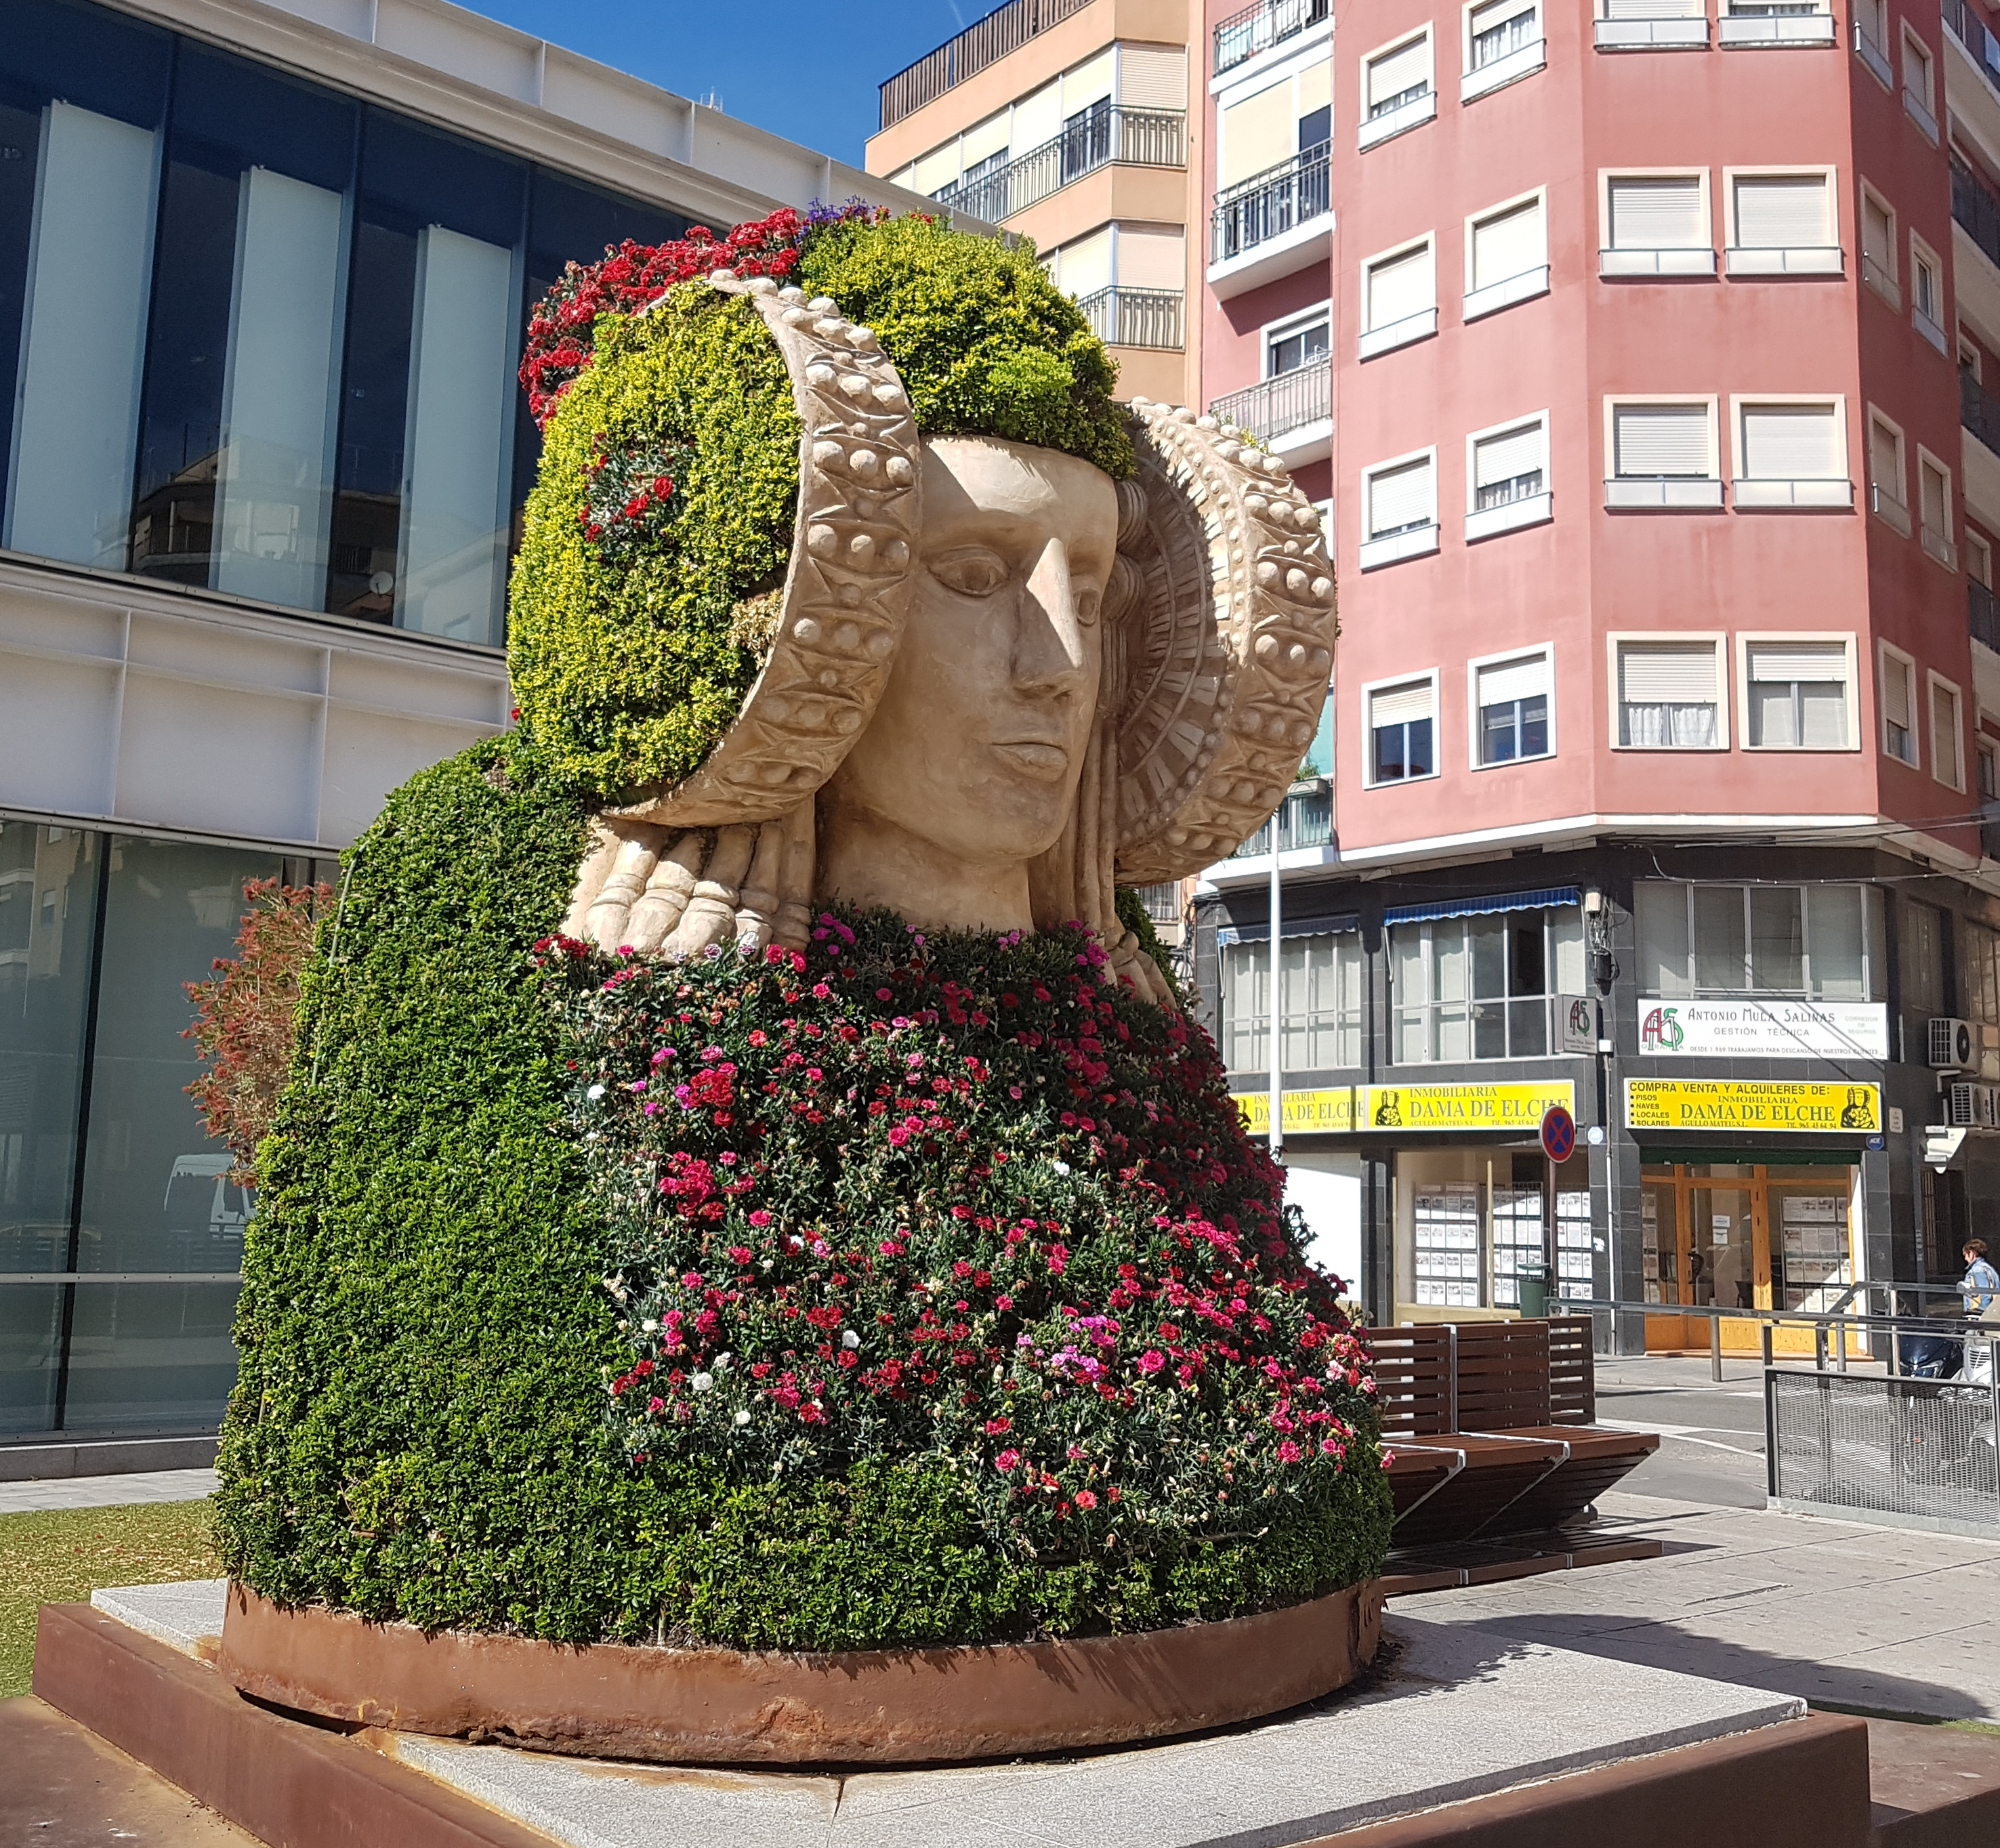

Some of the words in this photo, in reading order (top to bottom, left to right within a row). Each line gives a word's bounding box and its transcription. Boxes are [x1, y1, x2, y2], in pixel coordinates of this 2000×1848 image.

[1688, 1008, 1736, 1021] ANTONIO
[1743, 1008, 1774, 1022] MULA
[1784, 1009, 1835, 1022] SALINAS
[1714, 1026, 1757, 1035] GESTIÓN
[1767, 1028, 1810, 1036] TÉCNICA
[1410, 1086, 1497, 1097] INMOBILIARIA
[1629, 1082, 1677, 1092] COMPRA
[1683, 1083, 1718, 1093] VENTA
[1724, 1084, 1730, 1093] Y
[1736, 1084, 1805, 1095] ALQUILERES
[1812, 1085, 1830, 1095] DE:
[1255, 1092, 1316, 1104] INMILIARIA
[1718, 1095, 1798, 1104] INMOBILIARIA
[1255, 1105, 1293, 1122] DAA
[1297, 1104, 1314, 1120] DE
[1410, 1099, 1465, 1118] DAMA
[1470, 1099, 1496, 1116] DE
[1680, 1104, 1736, 1119] DAMA
[1741, 1105, 1766, 1120] DE
[1772, 1106, 1835, 1121] ELCHE
